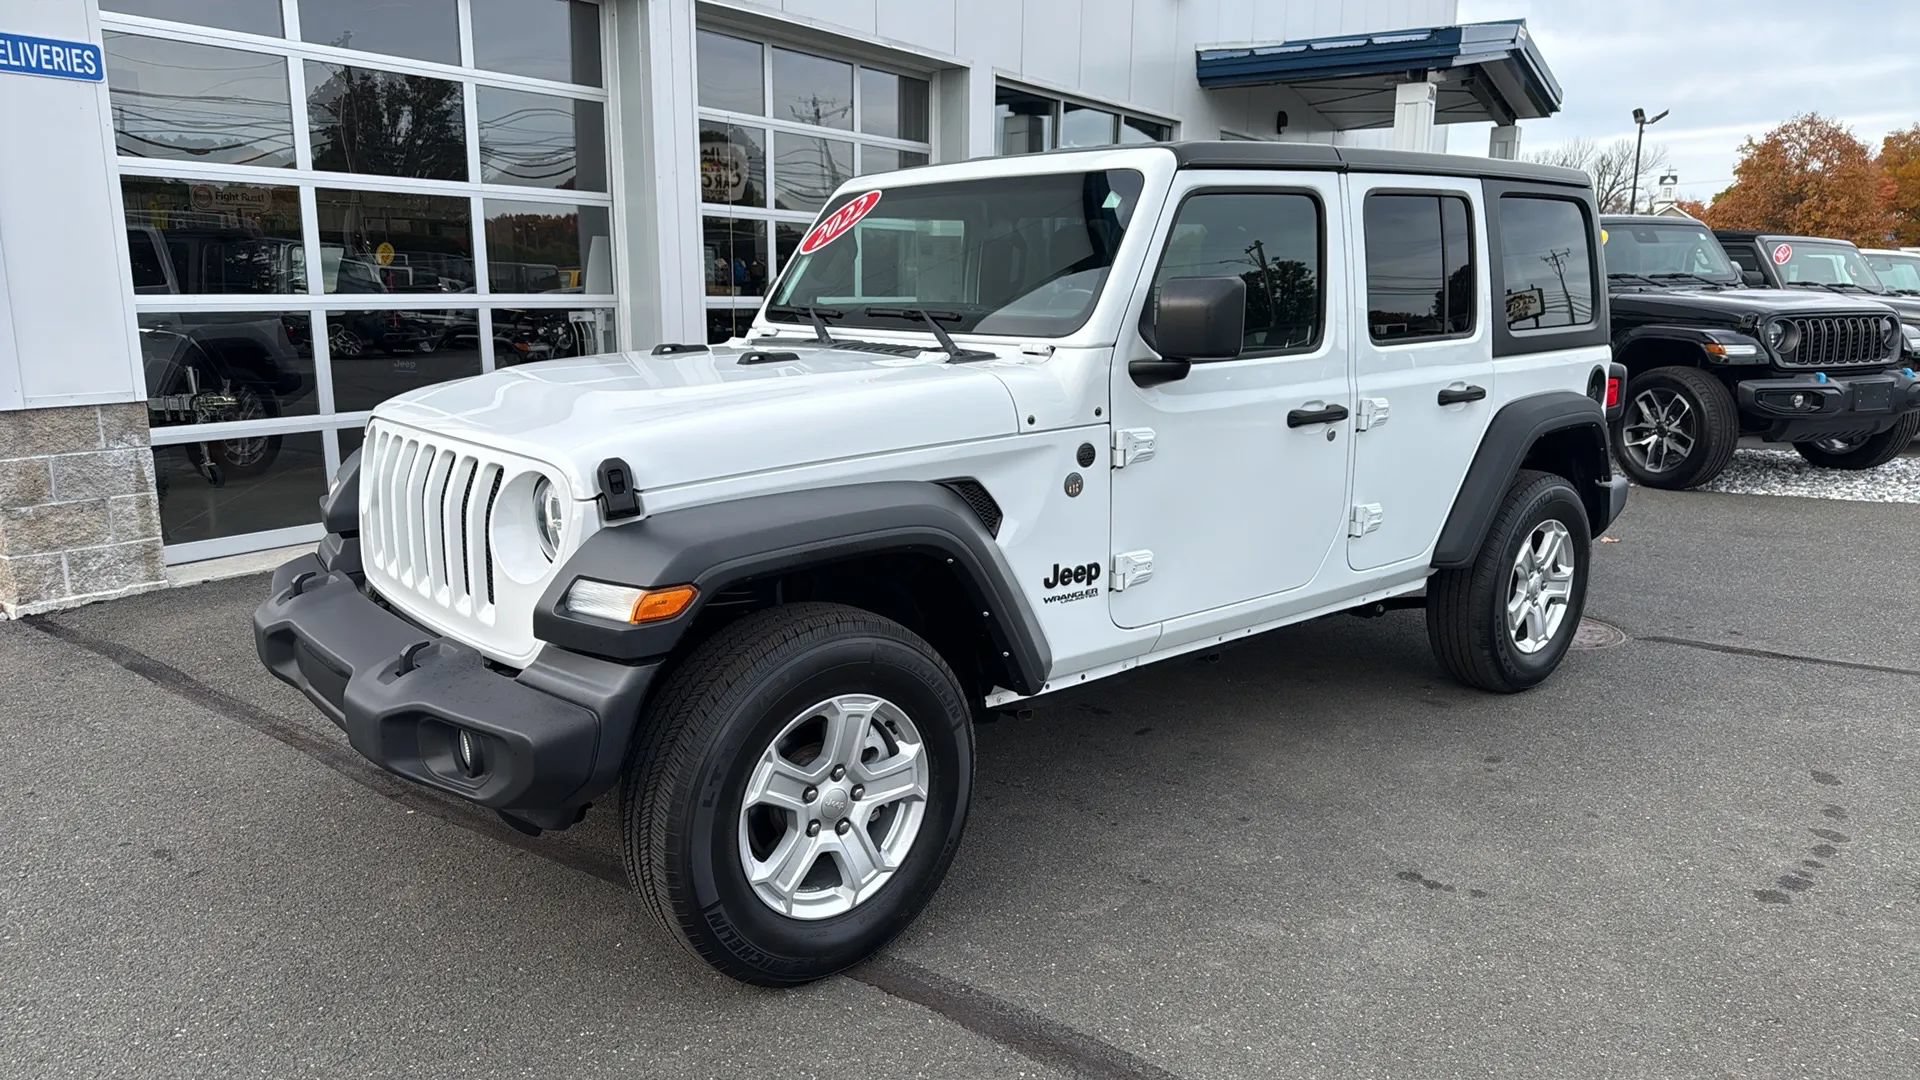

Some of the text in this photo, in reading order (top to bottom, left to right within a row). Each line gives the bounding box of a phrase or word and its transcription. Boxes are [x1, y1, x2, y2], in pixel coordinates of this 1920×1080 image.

[811, 196, 868, 249] 2022
[1043, 562, 1101, 589] Jeep
[1043, 587, 1098, 604] WRANGLER
